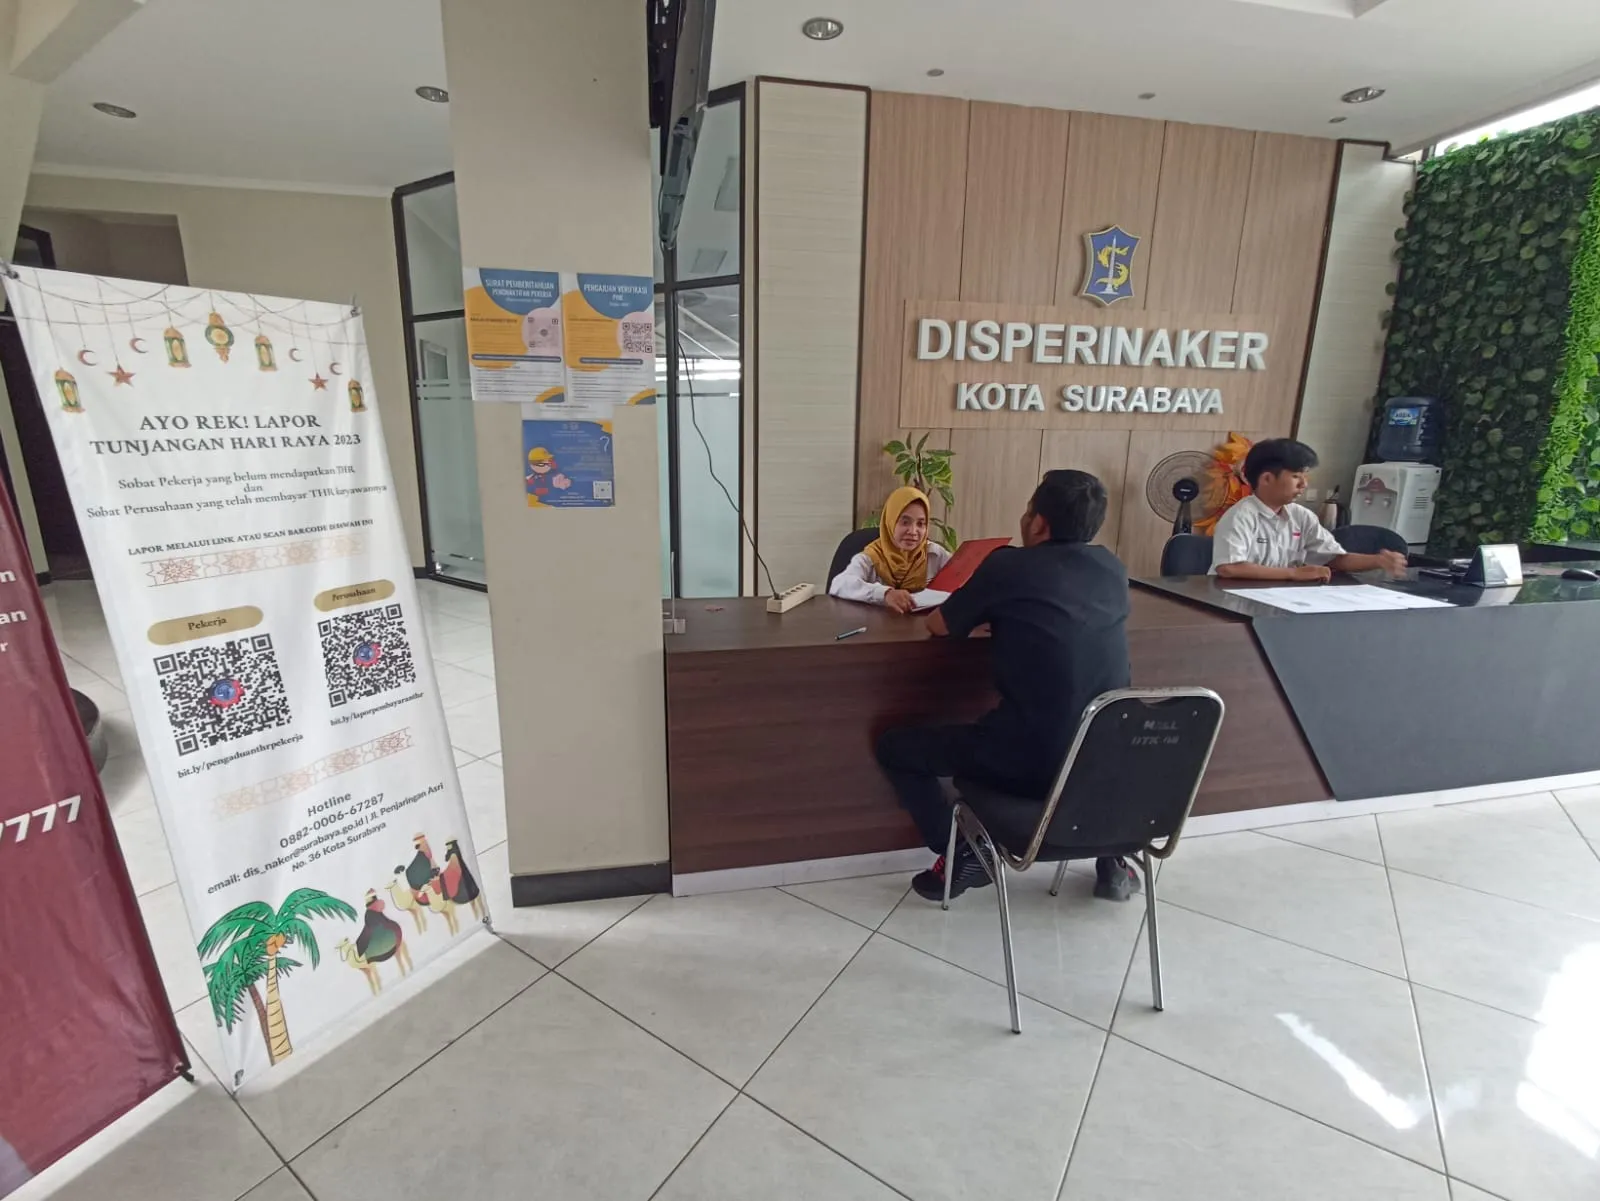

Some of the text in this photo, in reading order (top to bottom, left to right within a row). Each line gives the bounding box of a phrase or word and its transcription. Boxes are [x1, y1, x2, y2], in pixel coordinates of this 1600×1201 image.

[916, 318, 1269, 371] DISPERINAKER
[956, 382, 1224, 415] KOTA SURABAYA
[139, 414, 321, 431] AYO REK! LAPOR
[89, 433, 361, 456] TUNJANGAN HARI RAYA 2023
[118, 477, 156, 490] Sobat
[159, 475, 203, 487] Pekerja
[205, 474, 233, 487] yang
[233, 471, 268, 483] belum
[269, 466, 336, 480] mendapatkan
[243, 483, 263, 493] dan
[86, 506, 121, 519] Sobat
[123, 501, 194, 515] Perusahaan
[196, 498, 224, 512] yang
[225, 494, 253, 507] telah
[255, 490, 307, 504] membayar
[308, 487, 335, 499] THR
[128, 544, 164, 556] LAPOR
[165, 539, 210, 551] MELALUI
[211, 536, 235, 546] LINK
[236, 532, 263, 542] ATAU
[263, 529, 286, 540] SCAN
[287, 524, 328, 536] BARCODE
[187, 616, 228, 632] Pekerja
[177, 733, 304, 779] bit.ly/pengaduanthrpekerja
[0, 795, 81, 843] 777
[279, 792, 385, 849] 0882-0006-67287
[307, 792, 352, 818] Hotline
[207, 873, 242, 895] email:
[379, 791, 427, 816] Penjaringan
[427, 782, 444, 795] Asri
[291, 821, 387, 873] No. 36 Kota Surabaya
